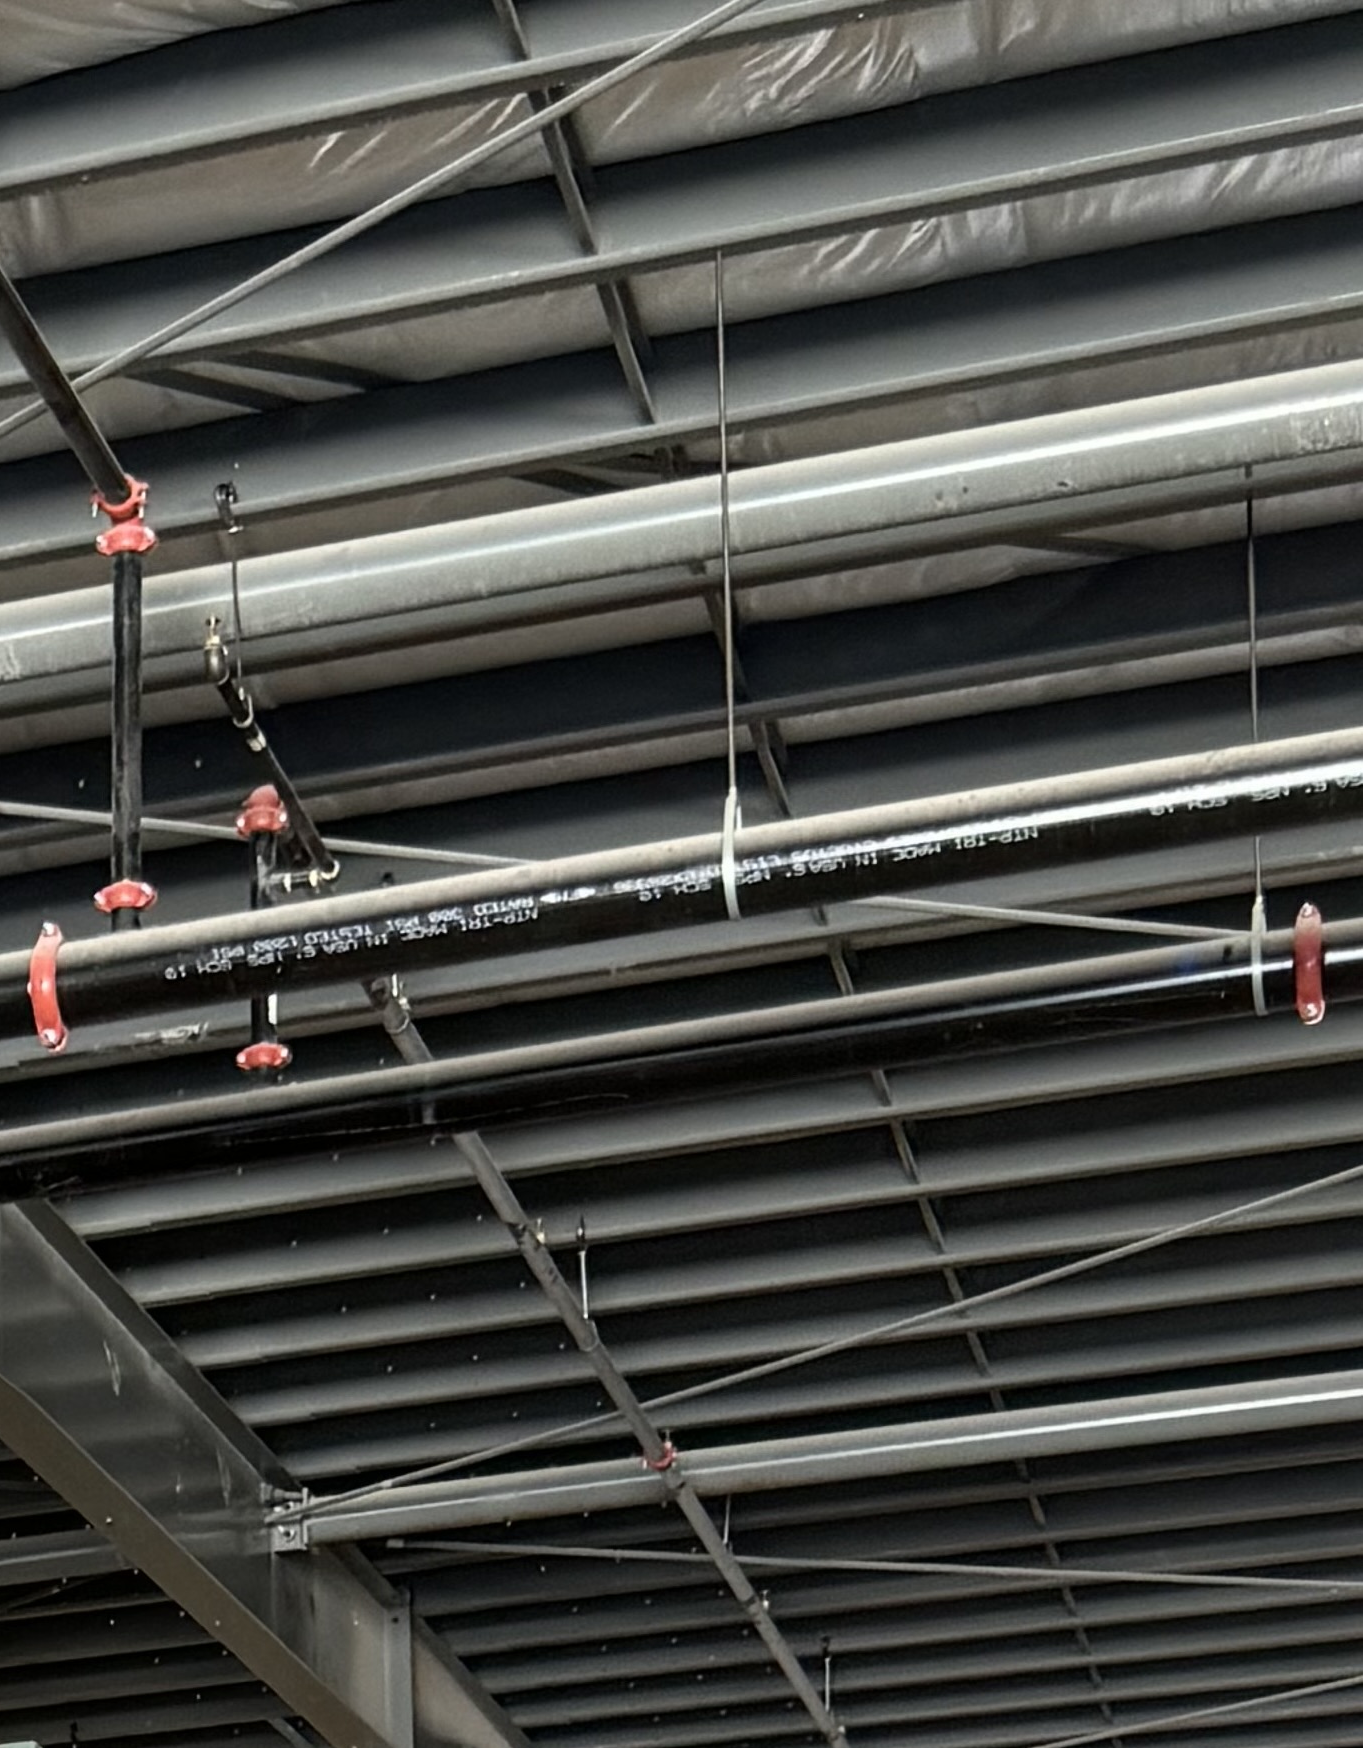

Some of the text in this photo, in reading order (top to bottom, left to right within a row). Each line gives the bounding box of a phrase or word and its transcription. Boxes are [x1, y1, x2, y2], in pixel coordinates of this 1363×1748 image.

[385, 913, 422, 933] PSI
[304, 924, 372, 946] TESTED
[210, 943, 246, 962] PSI
